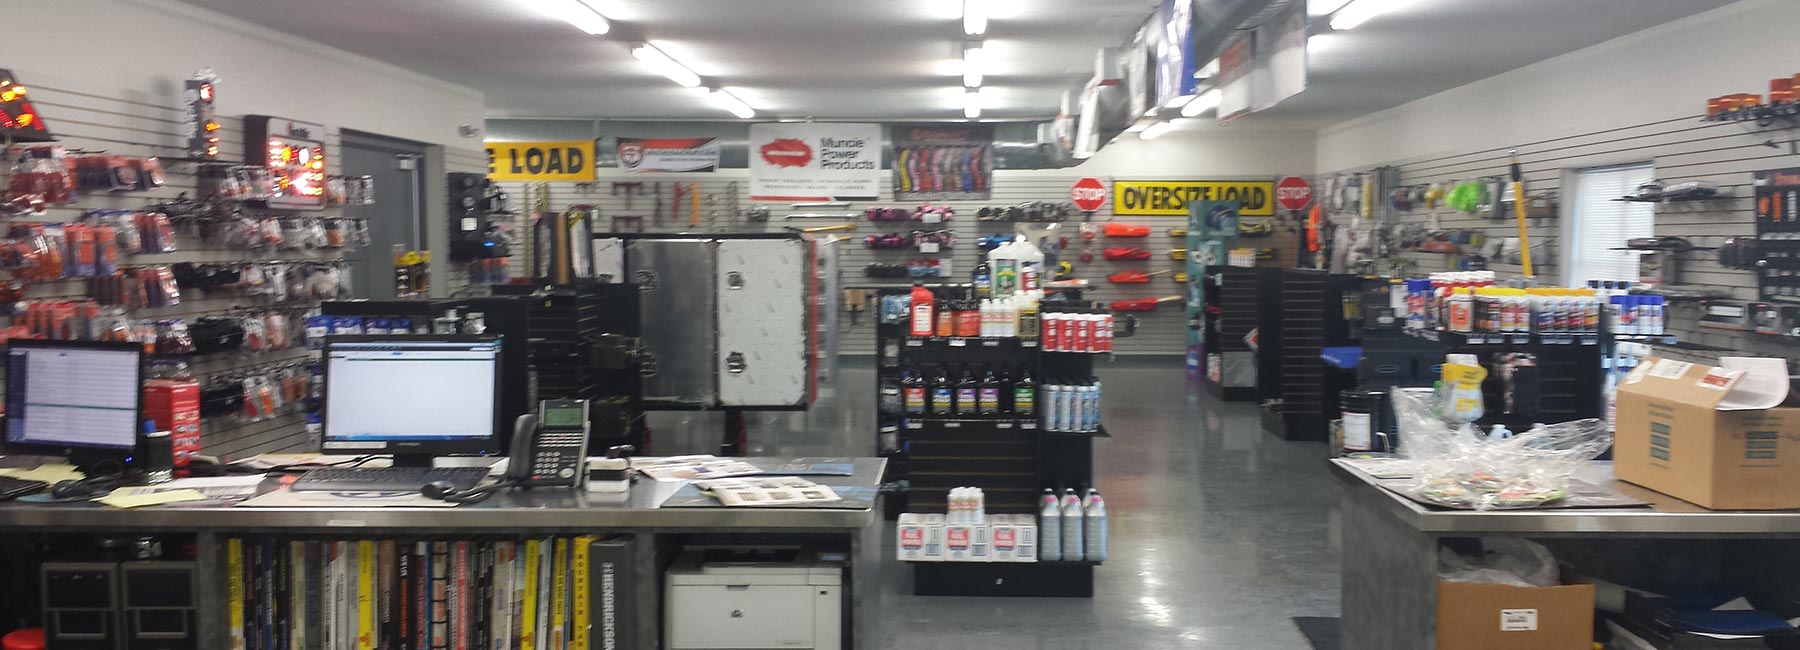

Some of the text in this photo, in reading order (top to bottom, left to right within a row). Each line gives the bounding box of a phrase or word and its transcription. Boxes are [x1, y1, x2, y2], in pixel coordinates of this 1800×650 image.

[820, 138, 865, 149] Muncie
[820, 148, 861, 159] Power
[510, 147, 584, 175] LOAD
[820, 159, 877, 170] Products
[1072, 187, 1106, 201] STOP
[1123, 186, 1266, 211] OVERSIZE LOAD
[1276, 187, 1311, 201] STOP
[601, 574, 616, 650] HENDRICKSON
